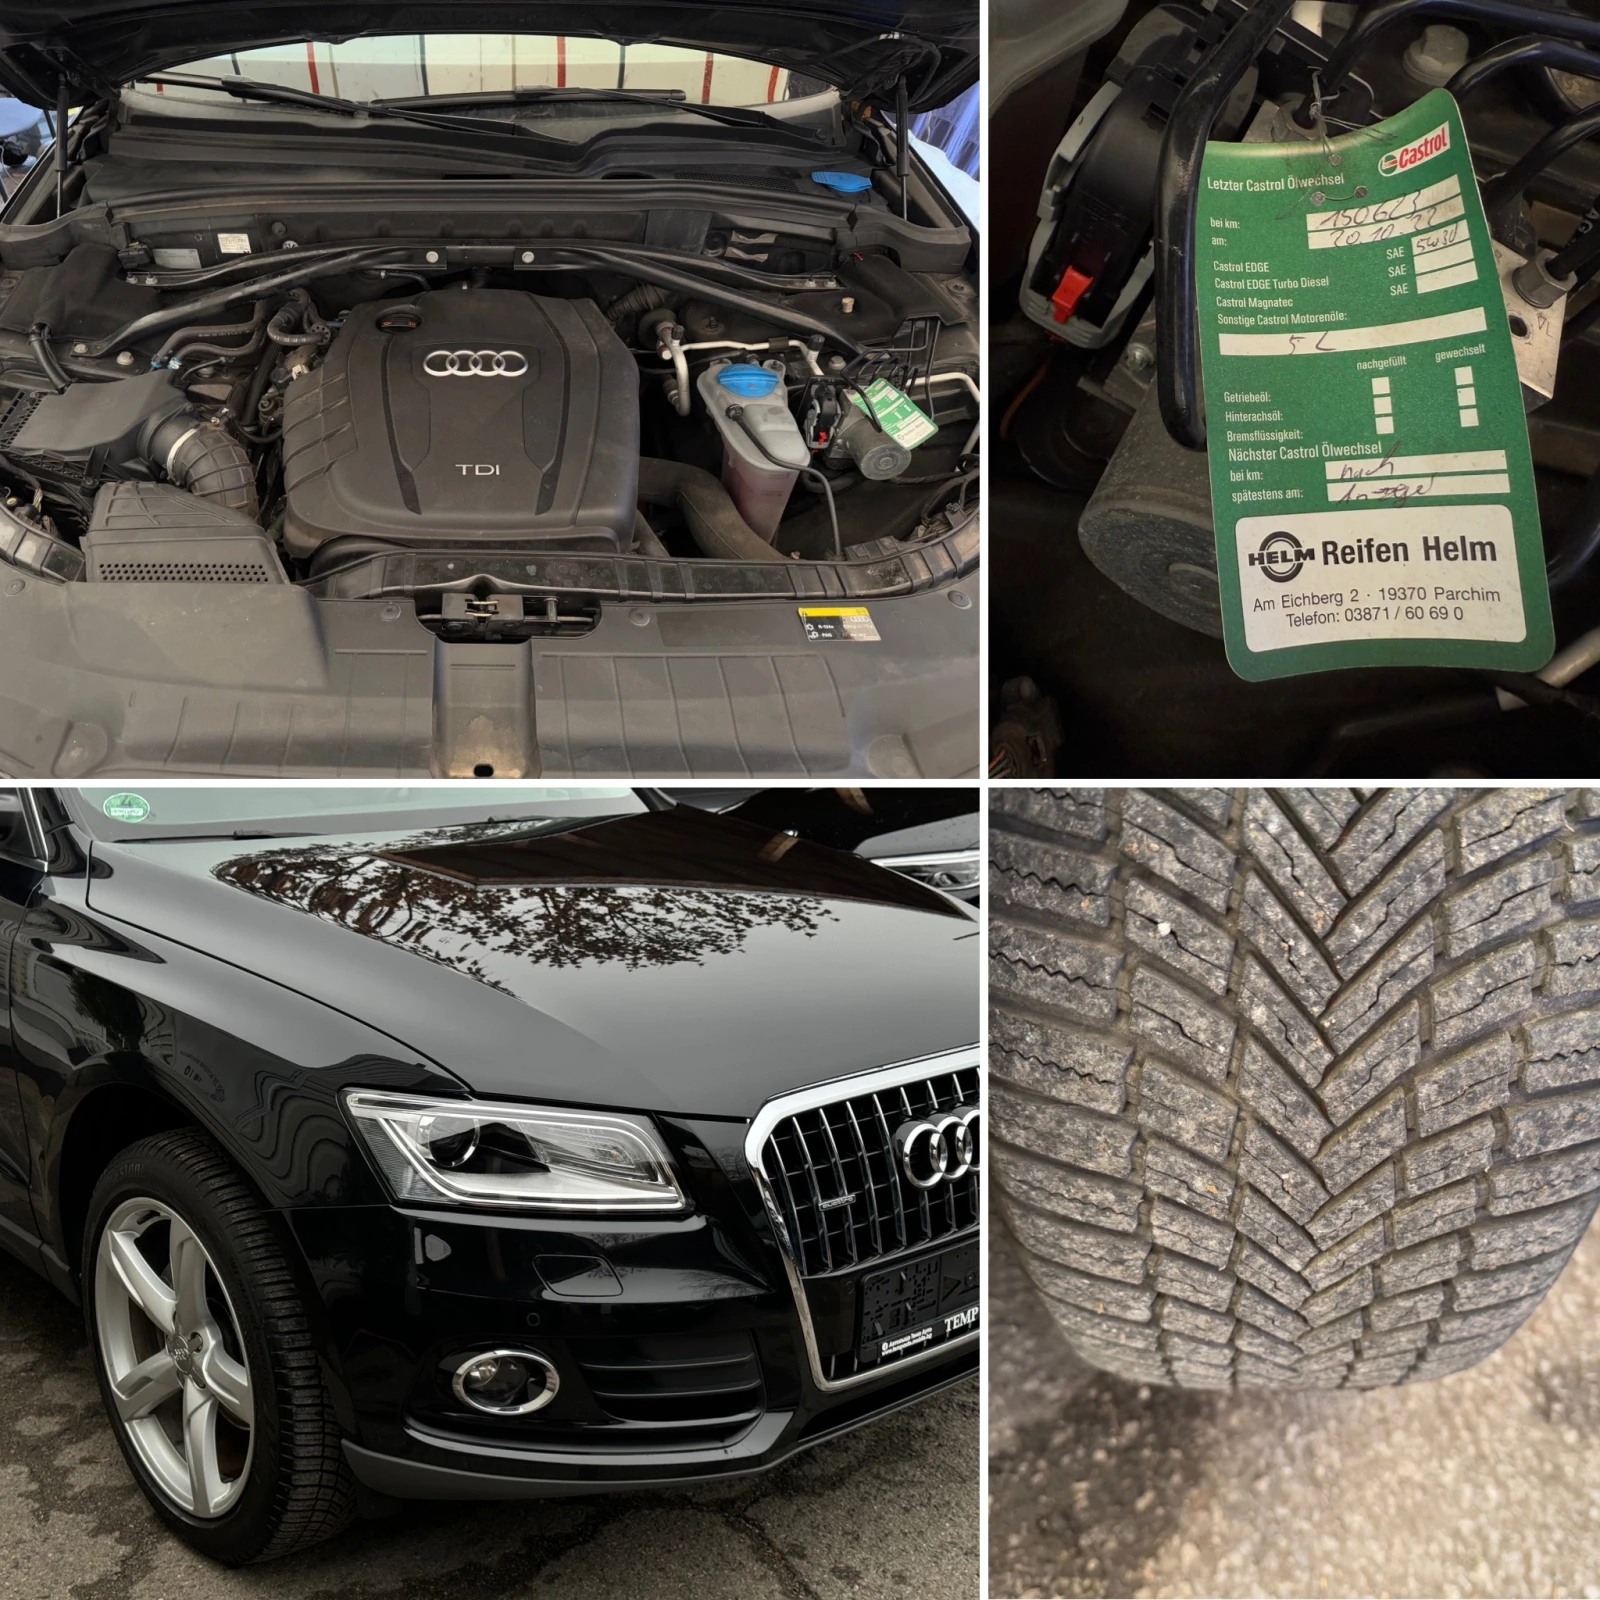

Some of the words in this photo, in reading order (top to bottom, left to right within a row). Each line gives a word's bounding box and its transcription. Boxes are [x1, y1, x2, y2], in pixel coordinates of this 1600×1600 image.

[1399, 127, 1448, 169] Castrol
[1207, 177, 1244, 191] Letzter
[1246, 178, 1285, 192] Castrol
[1287, 172, 1345, 189] Ölwechsel
[1210, 217, 1223, 228] bei
[1225, 218, 1240, 229] km:
[1211, 236, 1227, 246] am:
[1386, 246, 1405, 260] SAE
[1213, 260, 1244, 272] Castrol
[1245, 262, 1270, 273] EDGE
[1388, 264, 1407, 277] SAE
[1214, 278, 1245, 289] Castrol
[1247, 279, 1271, 290] EDGE
[1272, 278, 1299, 289] Turbo
[1301, 276, 1329, 288] Diesel
[1390, 283, 1409, 296] SAE
[1216, 296, 1246, 308] Castrol
[1248, 297, 1293, 310] Magnatec
[1217, 313, 1255, 327] Sonstige
[1257, 314, 1289, 326] Castrol
[1291, 310, 1347, 324] Motorenöle:
[1435, 343, 1486, 363] gewechselt
[1356, 355, 1407, 371] nachgefüllt
[1223, 391, 1271, 403] Getriebeöl:
[1225, 410, 1283, 422] Hinterachsöl:
[1227, 430, 1303, 443] Bremsflüssigkeit:
[1228, 448, 1277, 462] Nächster
[1279, 445, 1319, 460] Castrol
[1321, 440, 1382, 458] Ölwechsel
[455, 464, 500, 476] TDI
[1230, 469, 1244, 482] bei
[1246, 470, 1263, 481] km:
[1231, 489, 1283, 505] spätestens
[1285, 489, 1303, 499] am:
[1248, 547, 1316, 567] HELM
[1321, 537, 1410, 566] Reifen
[1422, 535, 1497, 562] Helm
[1253, 598, 1276, 612] Am
[1281, 591, 1344, 607] Eichberg
[1350, 588, 1359, 603] 2
[1378, 586, 1427, 601] 19370
[1434, 586, 1501, 602] Parchim
[1286, 610, 1340, 628] Telefon:
[944, 1306, 979, 1333] TEMP
